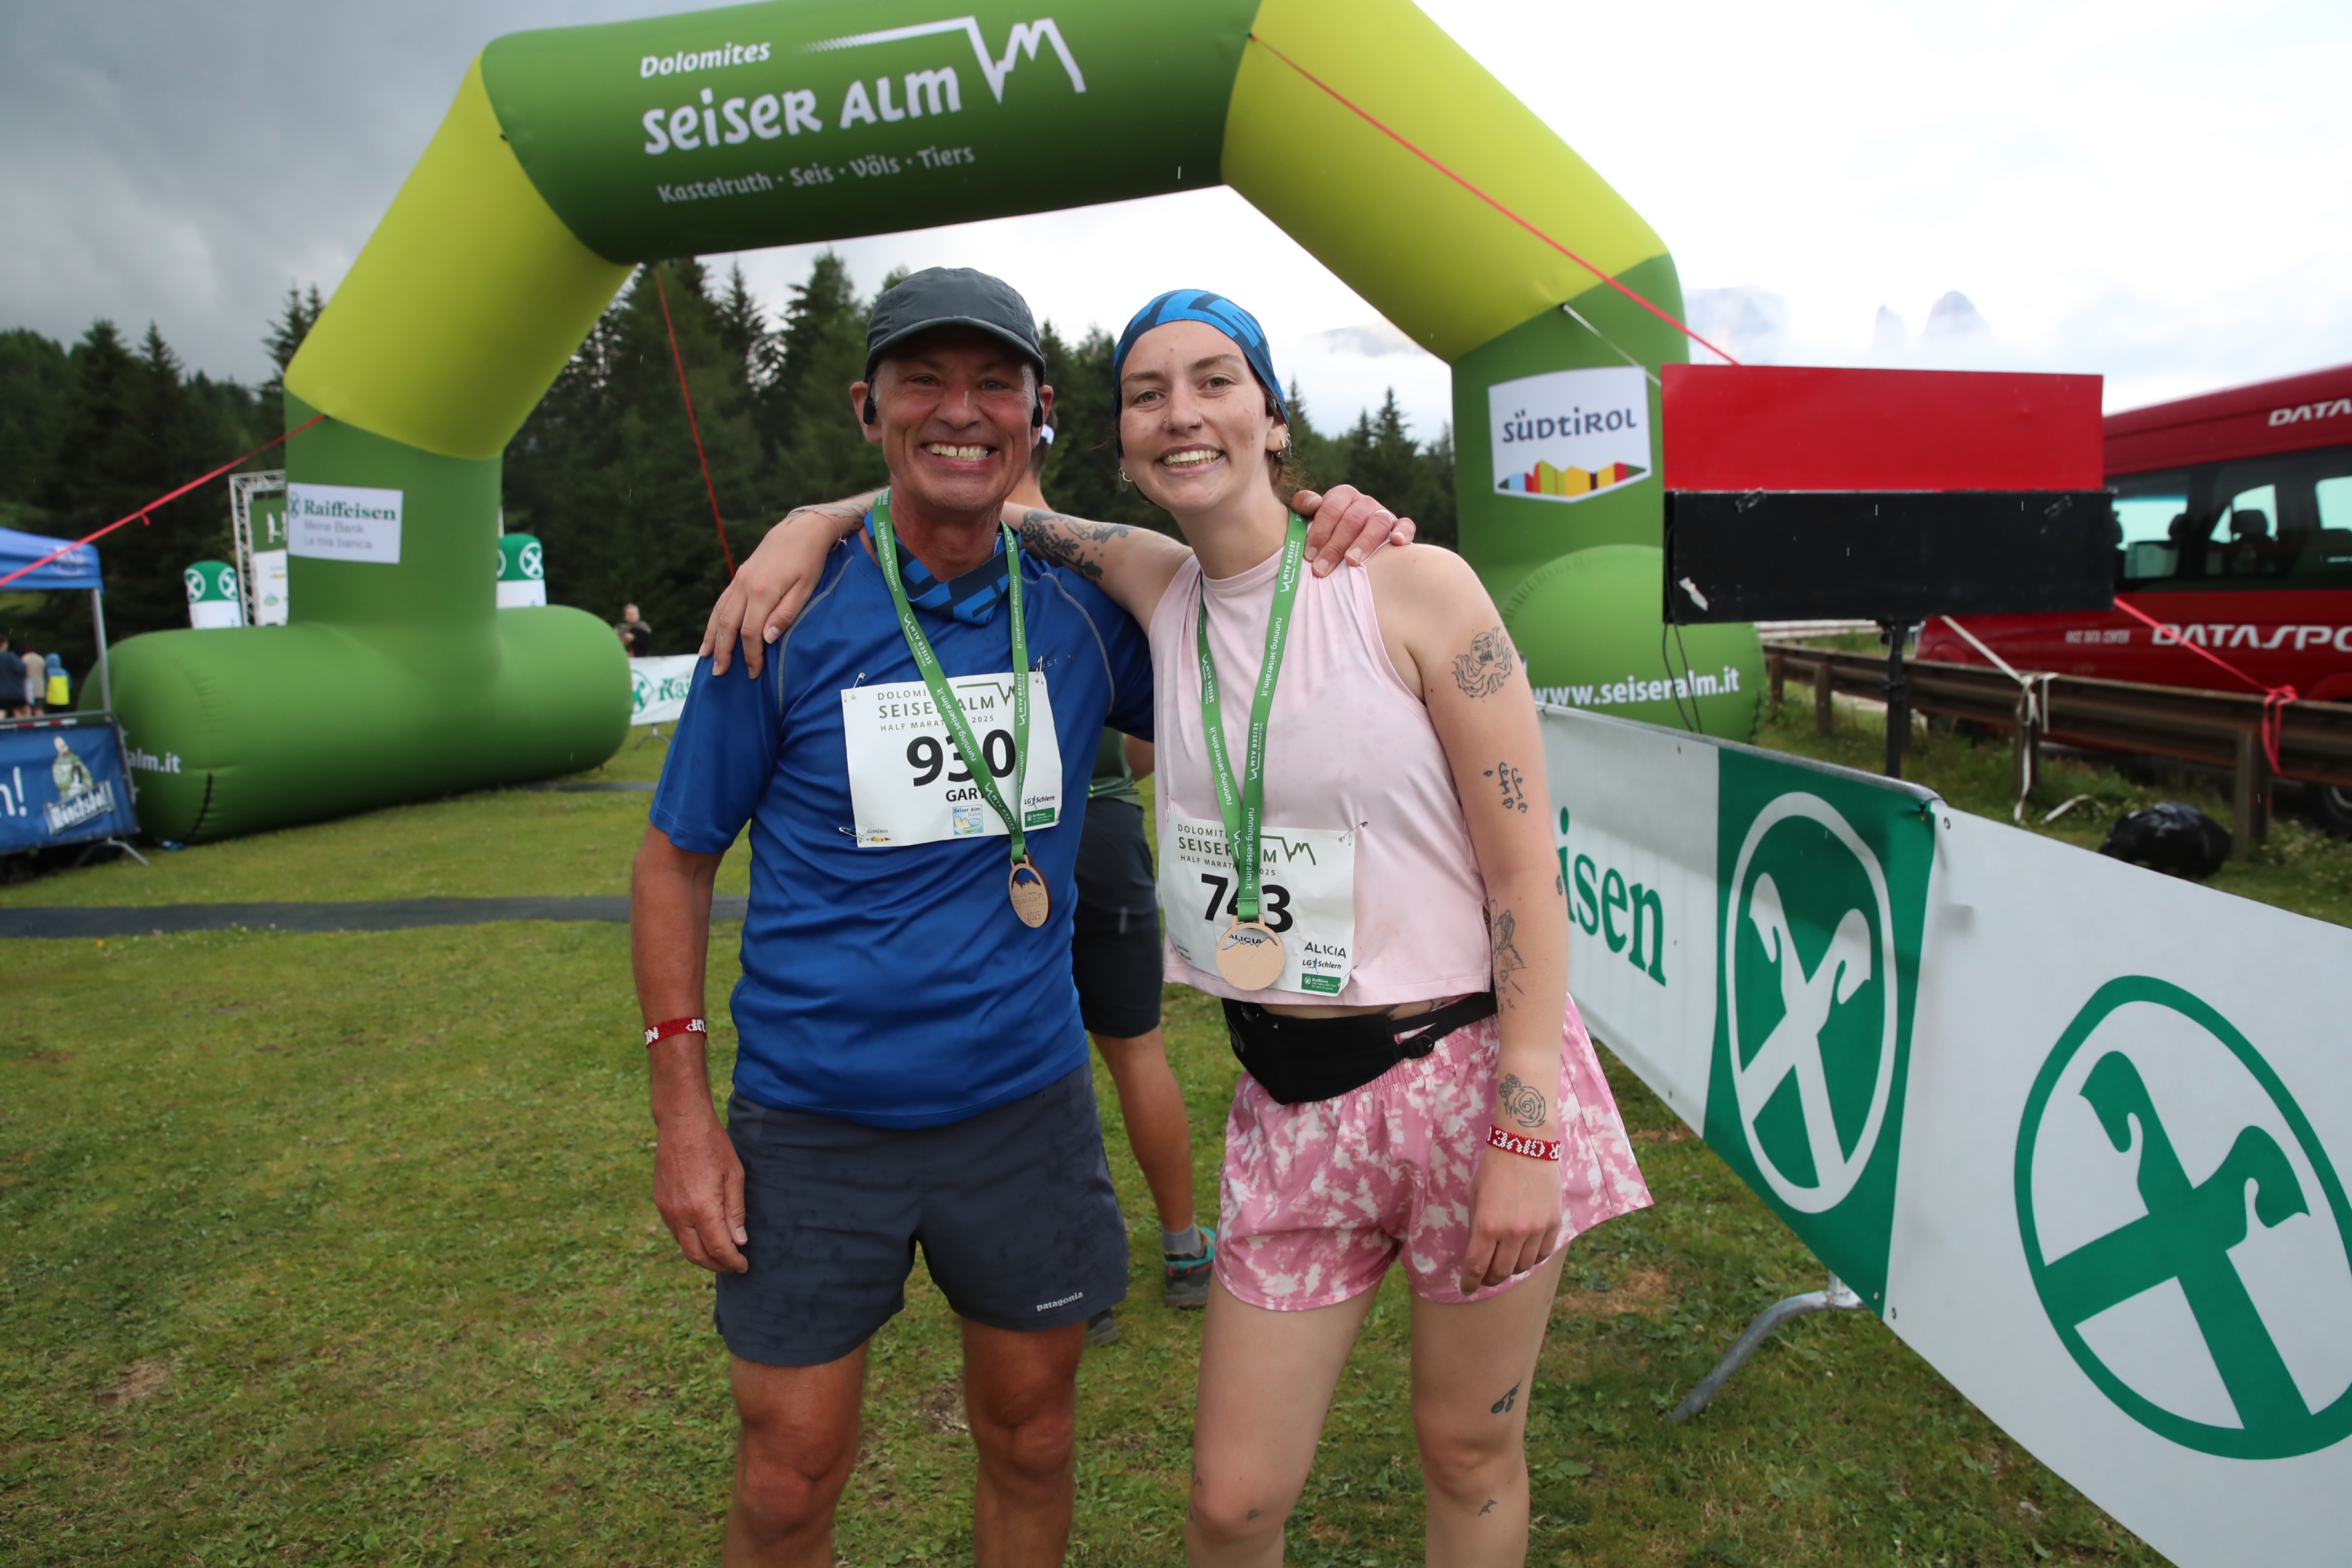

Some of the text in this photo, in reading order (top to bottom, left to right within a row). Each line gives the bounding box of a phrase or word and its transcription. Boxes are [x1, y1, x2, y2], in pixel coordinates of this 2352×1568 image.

[640, 41, 771, 79] Dolomites
[657, 144, 976, 204] Kastelruth Seis Völs Tiers
[304, 498, 397, 521] Raiffeisen
[879, 521, 897, 592] running.seiseralm.it
[1286, 540, 1296, 564] SEISER
[1013, 575, 1022, 649] running.seiseralm.it
[910, 625, 932, 665] SEISER ALM
[1260, 617, 1282, 697] running.seiseralm.it
[877, 689, 932, 701] DOLOMI
[1531, 665, 1740, 707] www.seiseralm.it
[879, 701, 939, 719] SEISE
[881, 723, 906, 732] HALF
[972, 715, 995, 723] 2025
[936, 687, 977, 761] running.seiseralm.it
[906, 729, 1016, 787] 930
[1209, 726, 1232, 805] running.seiseralm.it
[1178, 824, 1228, 838] DOLOMIT
[1245, 807, 1255, 890] running.seiseralm.it
[1181, 854, 1200, 864] HALF
[1260, 868, 1275, 876] 025
[1026, 910, 1041, 921] 2025
[1229, 934, 1262, 944] ALICIA
[1304, 941, 1347, 959] ALICIA
[1318, 961, 1342, 969] Schlern
[1036, 1291, 1084, 1312] patagonia
